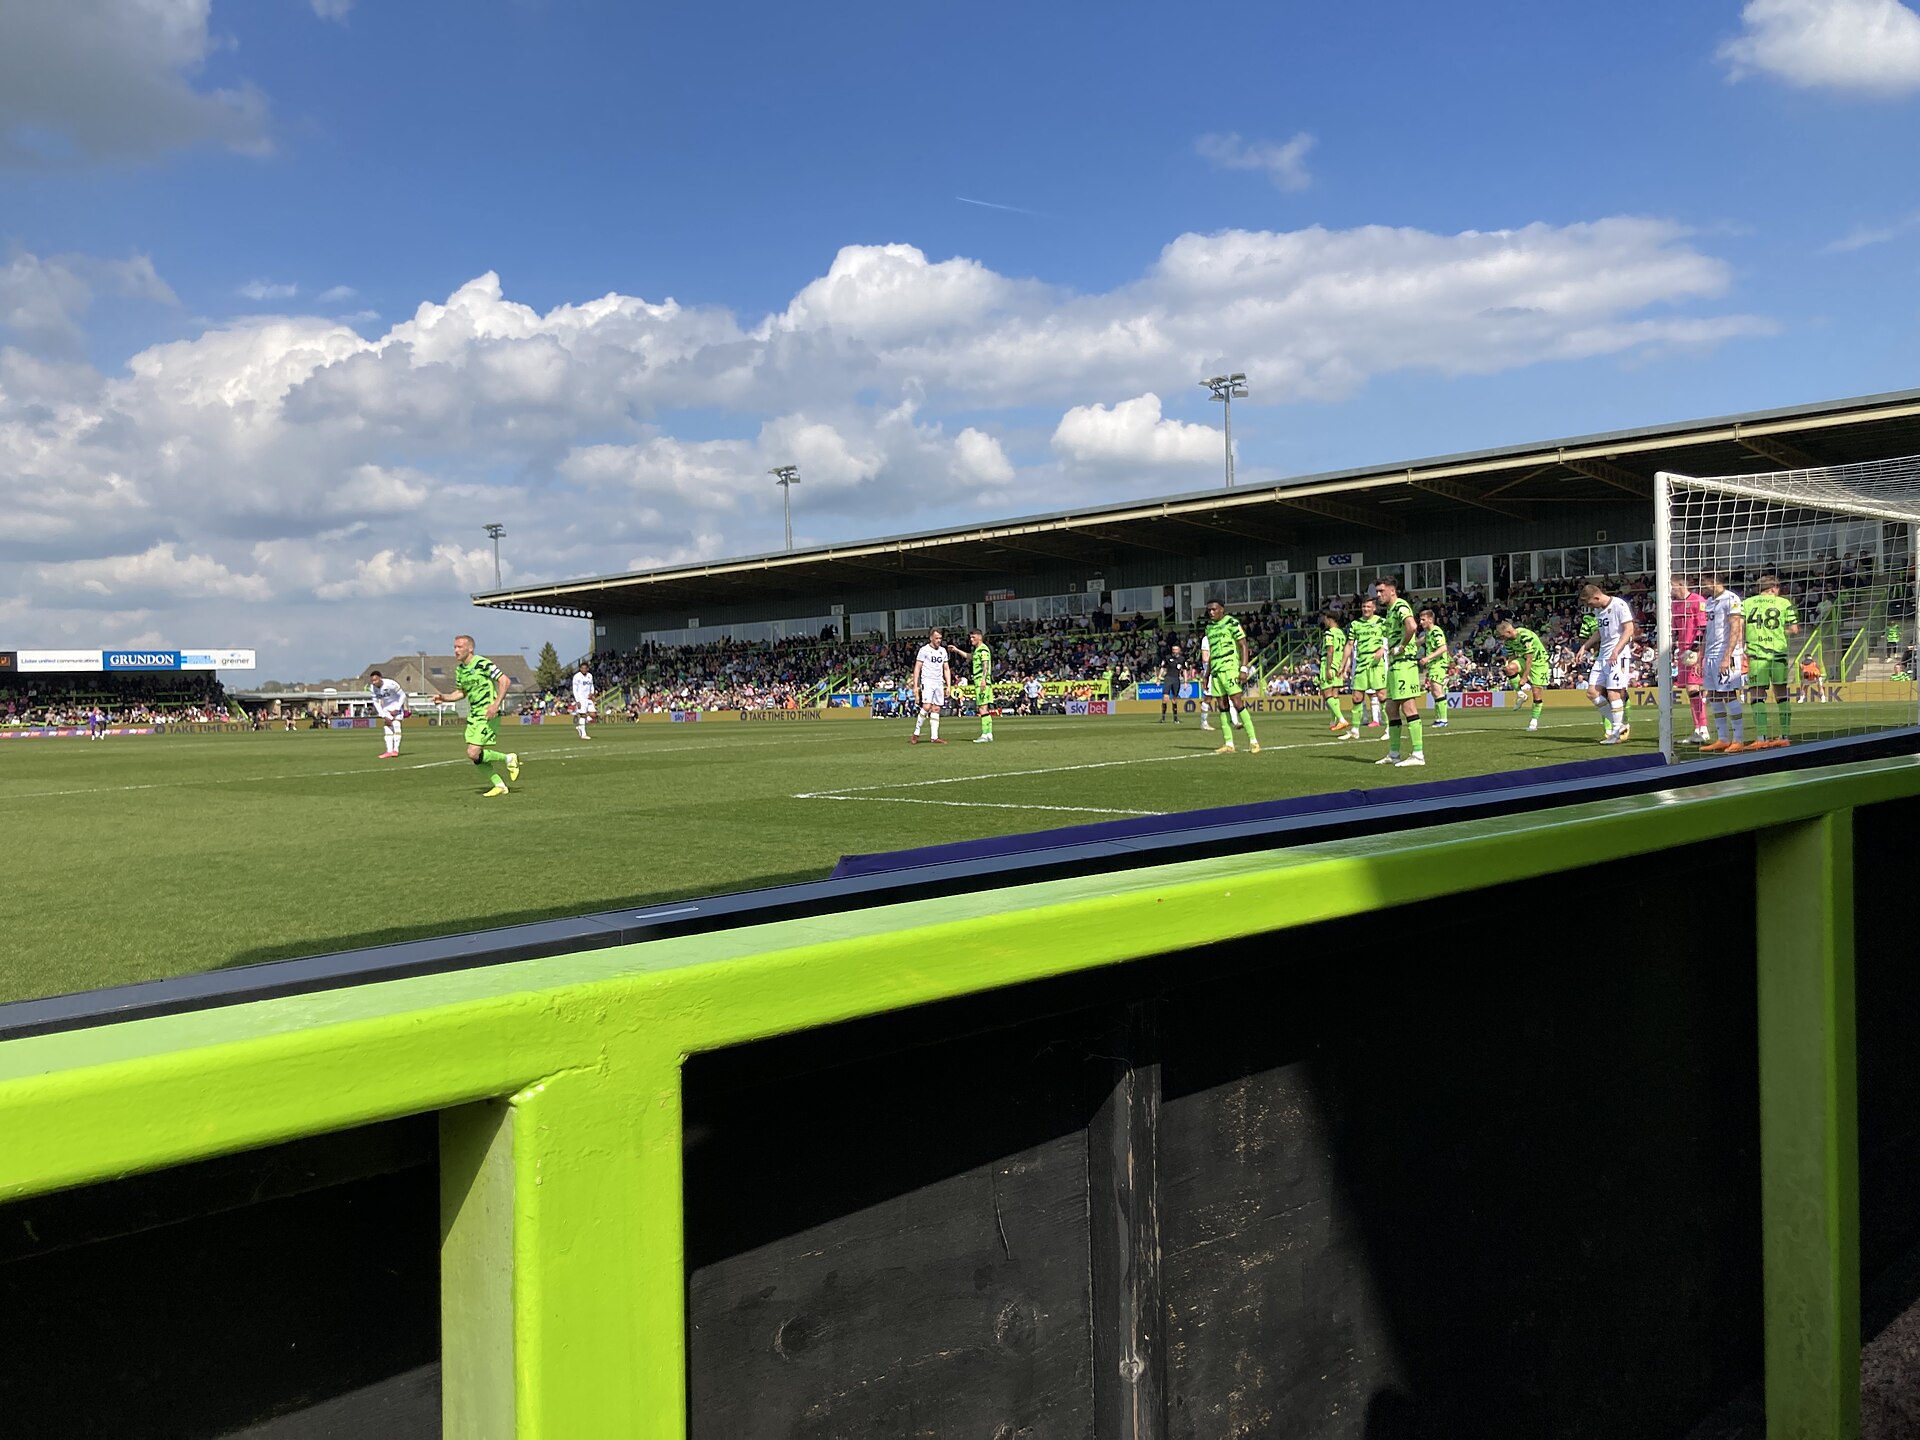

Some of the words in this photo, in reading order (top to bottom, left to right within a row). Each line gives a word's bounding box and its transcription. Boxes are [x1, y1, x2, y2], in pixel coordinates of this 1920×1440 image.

[1747, 607, 1780, 630] 48
[110, 654, 174, 664] GRUNDON
[221, 657, 250, 666] greiner
[1613, 673, 1620, 681] 4
[1398, 680, 1406, 690] 2
[1465, 693, 1490, 706] bet
[1635, 690, 1683, 705] TAE
[1071, 703, 1087, 714] sky
[1090, 702, 1106, 712] bet
[1267, 700, 1285, 711] TO
[749, 712, 766, 720] TAKE
[767, 711, 786, 720] TIME
[786, 711, 796, 720] TO
[796, 711, 821, 720] THINK
[169, 724, 195, 734] TAKE
[224, 723, 239, 732] TO
[337, 720, 353, 728] sky
